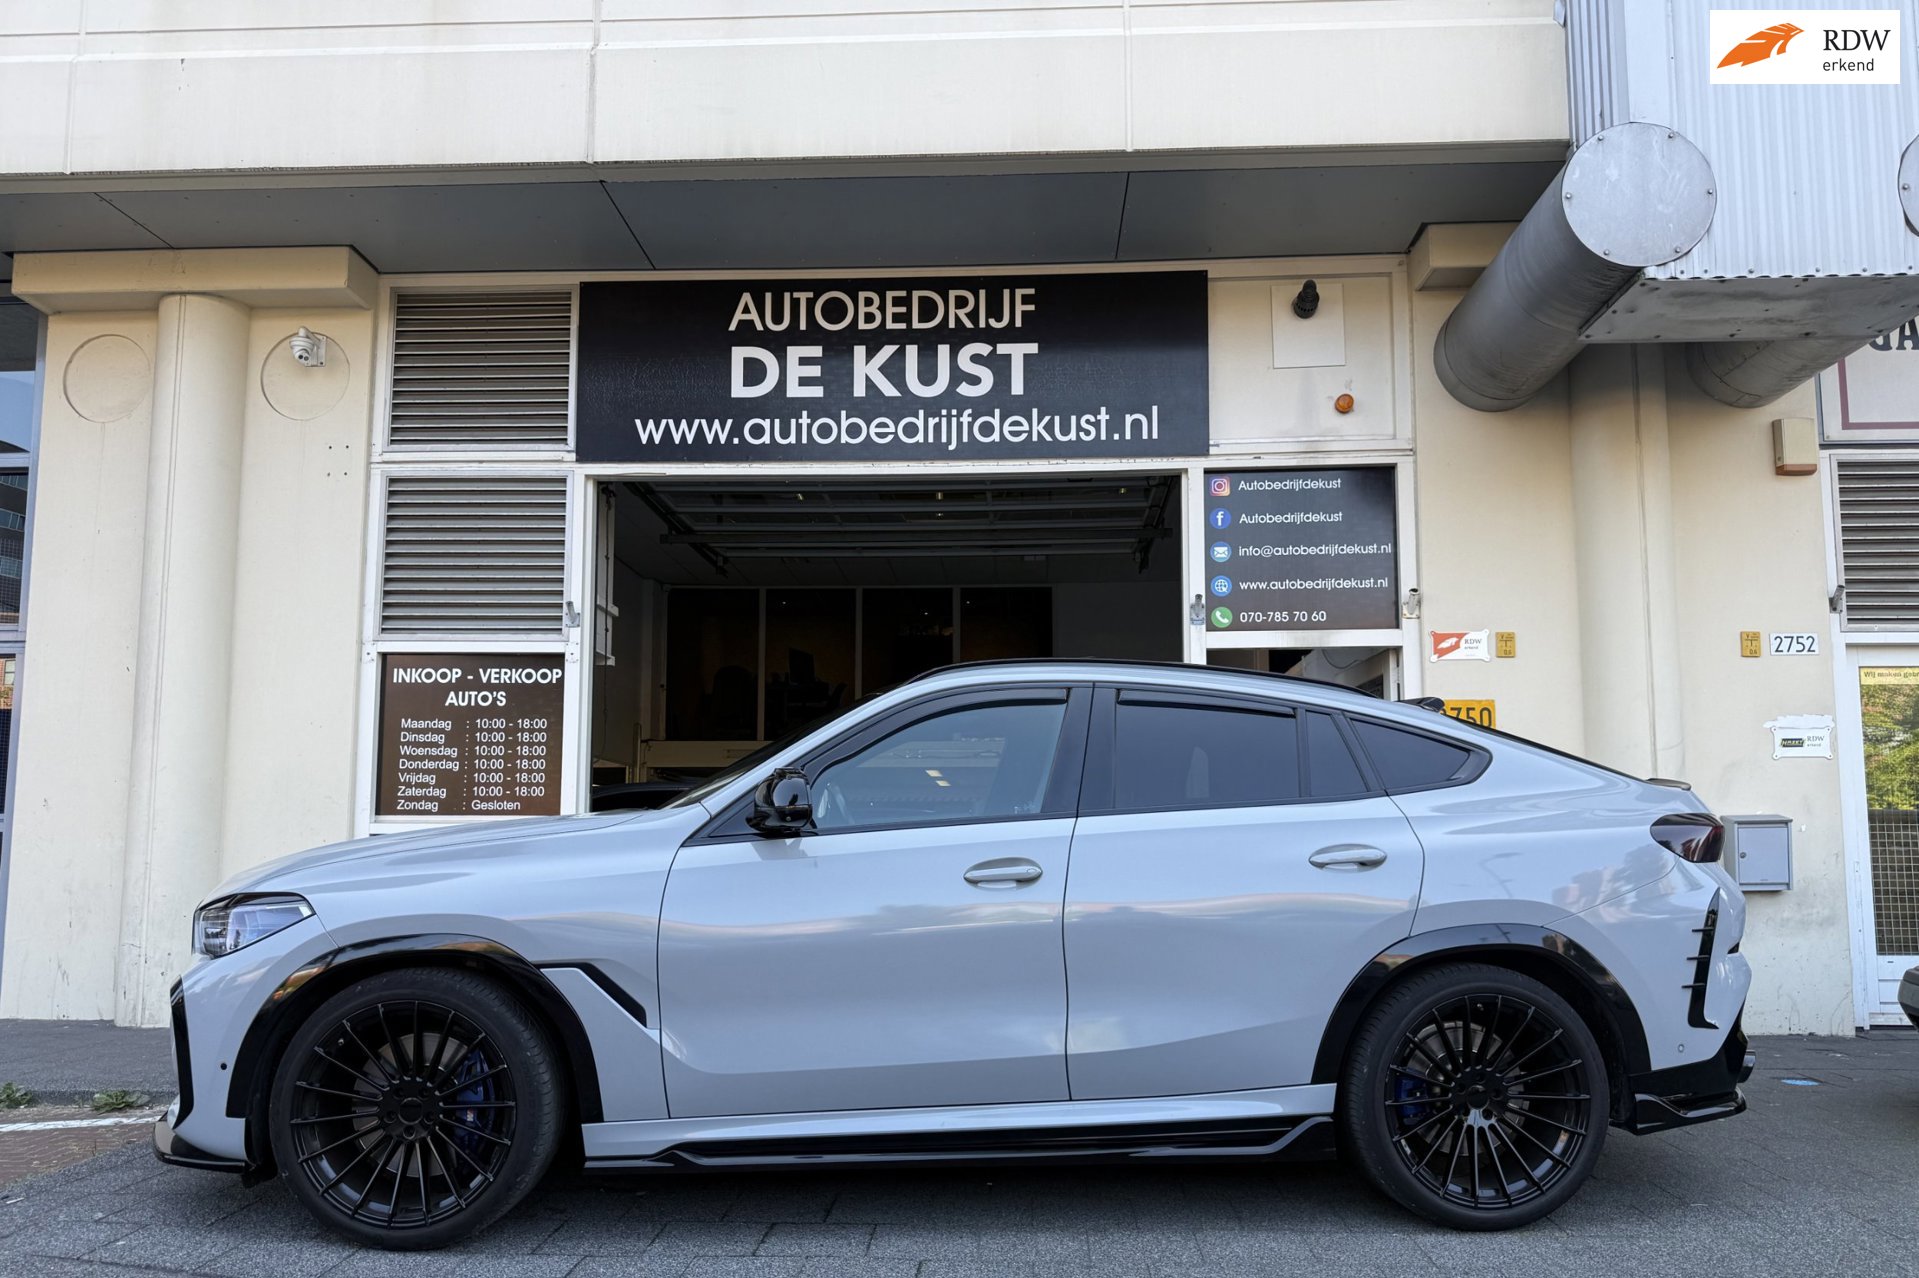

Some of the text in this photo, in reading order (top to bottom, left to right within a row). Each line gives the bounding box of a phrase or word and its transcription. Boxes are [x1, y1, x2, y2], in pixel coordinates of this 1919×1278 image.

[728, 288, 1036, 331] AUTOBEDRIJF
[731, 342, 1039, 398] DE KUST
[634, 405, 1159, 450] www.autobedrijfdekust.nl
[1238, 478, 1342, 491] Autobedrijfdekust
[1239, 511, 1343, 525] Autobedrijfdekust
[1238, 543, 1392, 558] info@autobedrijfdekust.nl
[1239, 577, 1388, 591] www.autobedrijfdekust.nl
[1239, 610, 1327, 623] 070-785 70 60
[1773, 635, 1816, 654] 2752
[393, 668, 462, 684] INKOOP
[479, 668, 562, 684] VERKOOP
[1440, 706, 1492, 728] 750
[401, 718, 452, 731] Maandag
[476, 718, 506, 728] 10:00
[517, 718, 548, 728] 18:00
[400, 732, 445, 744] Dinsdag
[474, 732, 505, 742] 10:00
[516, 732, 547, 742] 18:00
[400, 746, 458, 758] Woensdag
[474, 746, 504, 756] 10:00
[516, 746, 546, 756] 18:00
[399, 759, 460, 772] Donderdag
[474, 759, 504, 769] 10:00
[516, 759, 546, 769] 18:00
[398, 772, 436, 784] Vrijdag
[473, 772, 504, 782] 10:00
[515, 772, 546, 782] 18:00
[397, 786, 447, 798] Zaterdag
[472, 786, 503, 796] 10:00
[514, 786, 544, 796] 18:00
[396, 800, 438, 812] Zondag
[472, 800, 520, 810] Gesloten
